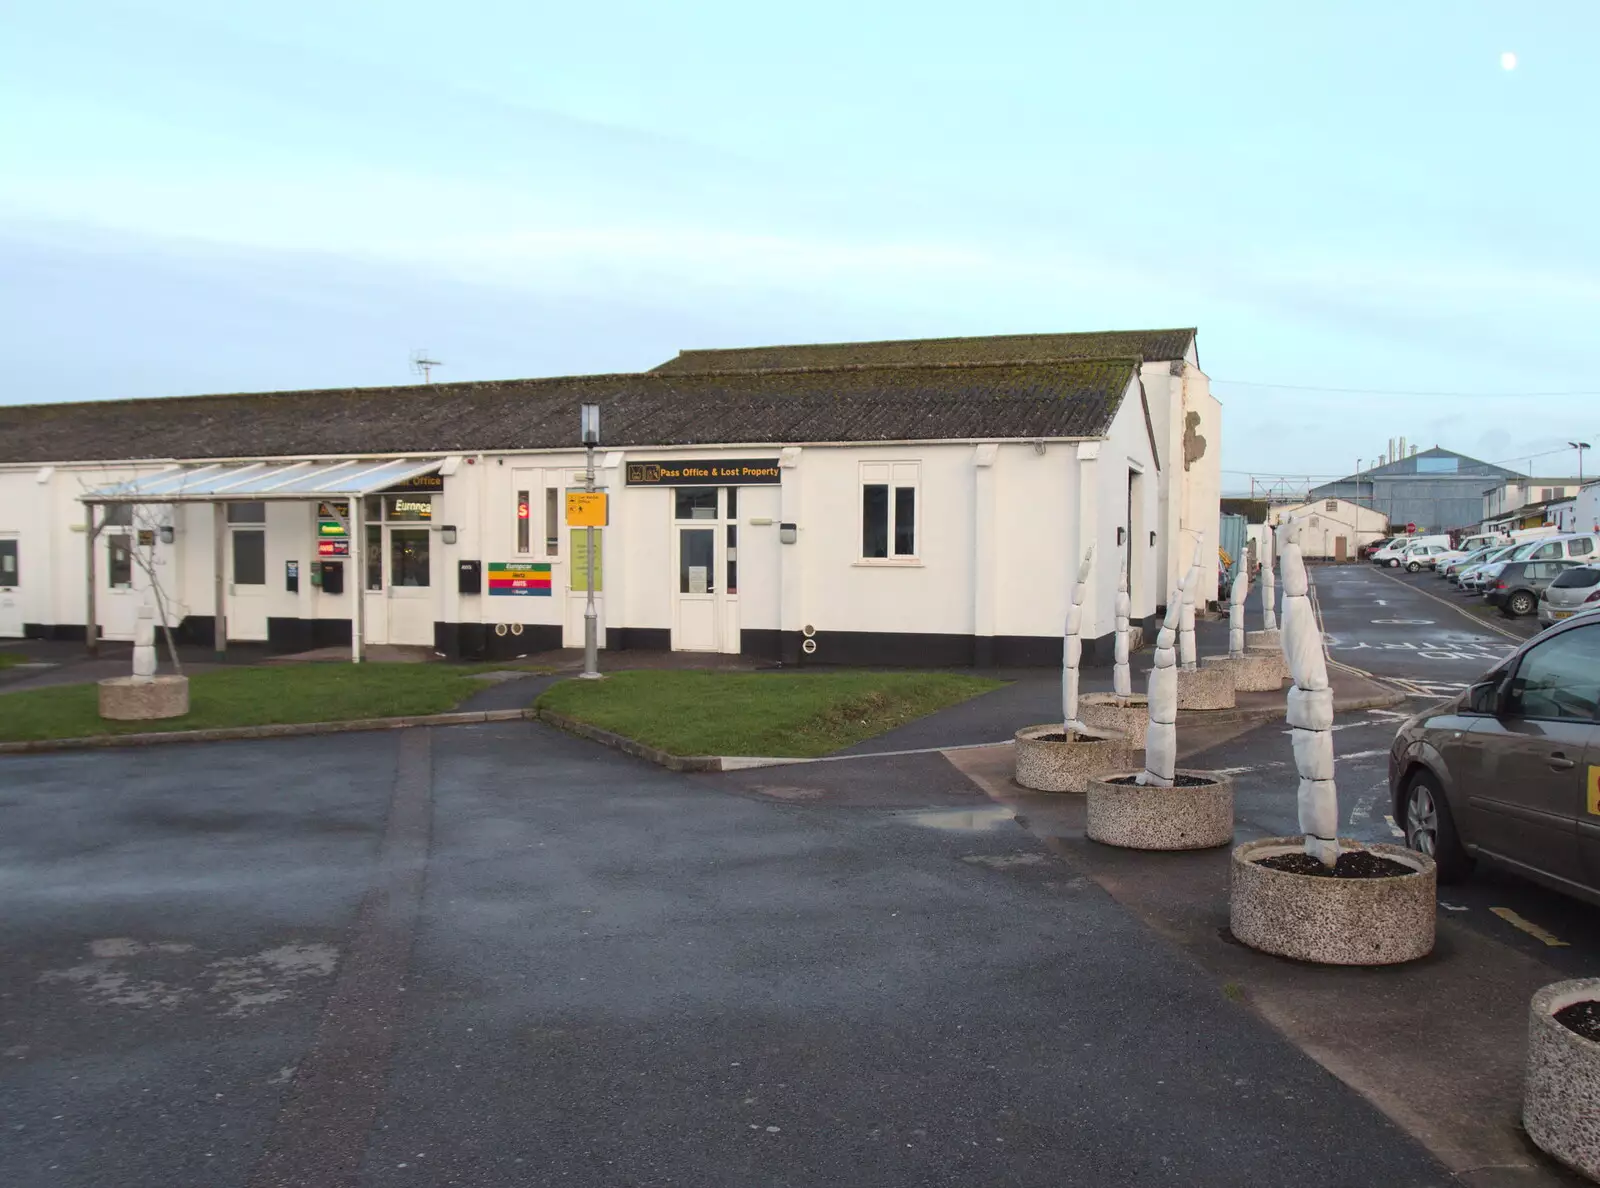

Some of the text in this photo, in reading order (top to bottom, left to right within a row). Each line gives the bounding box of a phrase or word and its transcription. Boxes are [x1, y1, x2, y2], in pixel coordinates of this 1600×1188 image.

[660, 467, 778, 477] Pass Office & Lost Property
[395, 499, 432, 513] Europca
